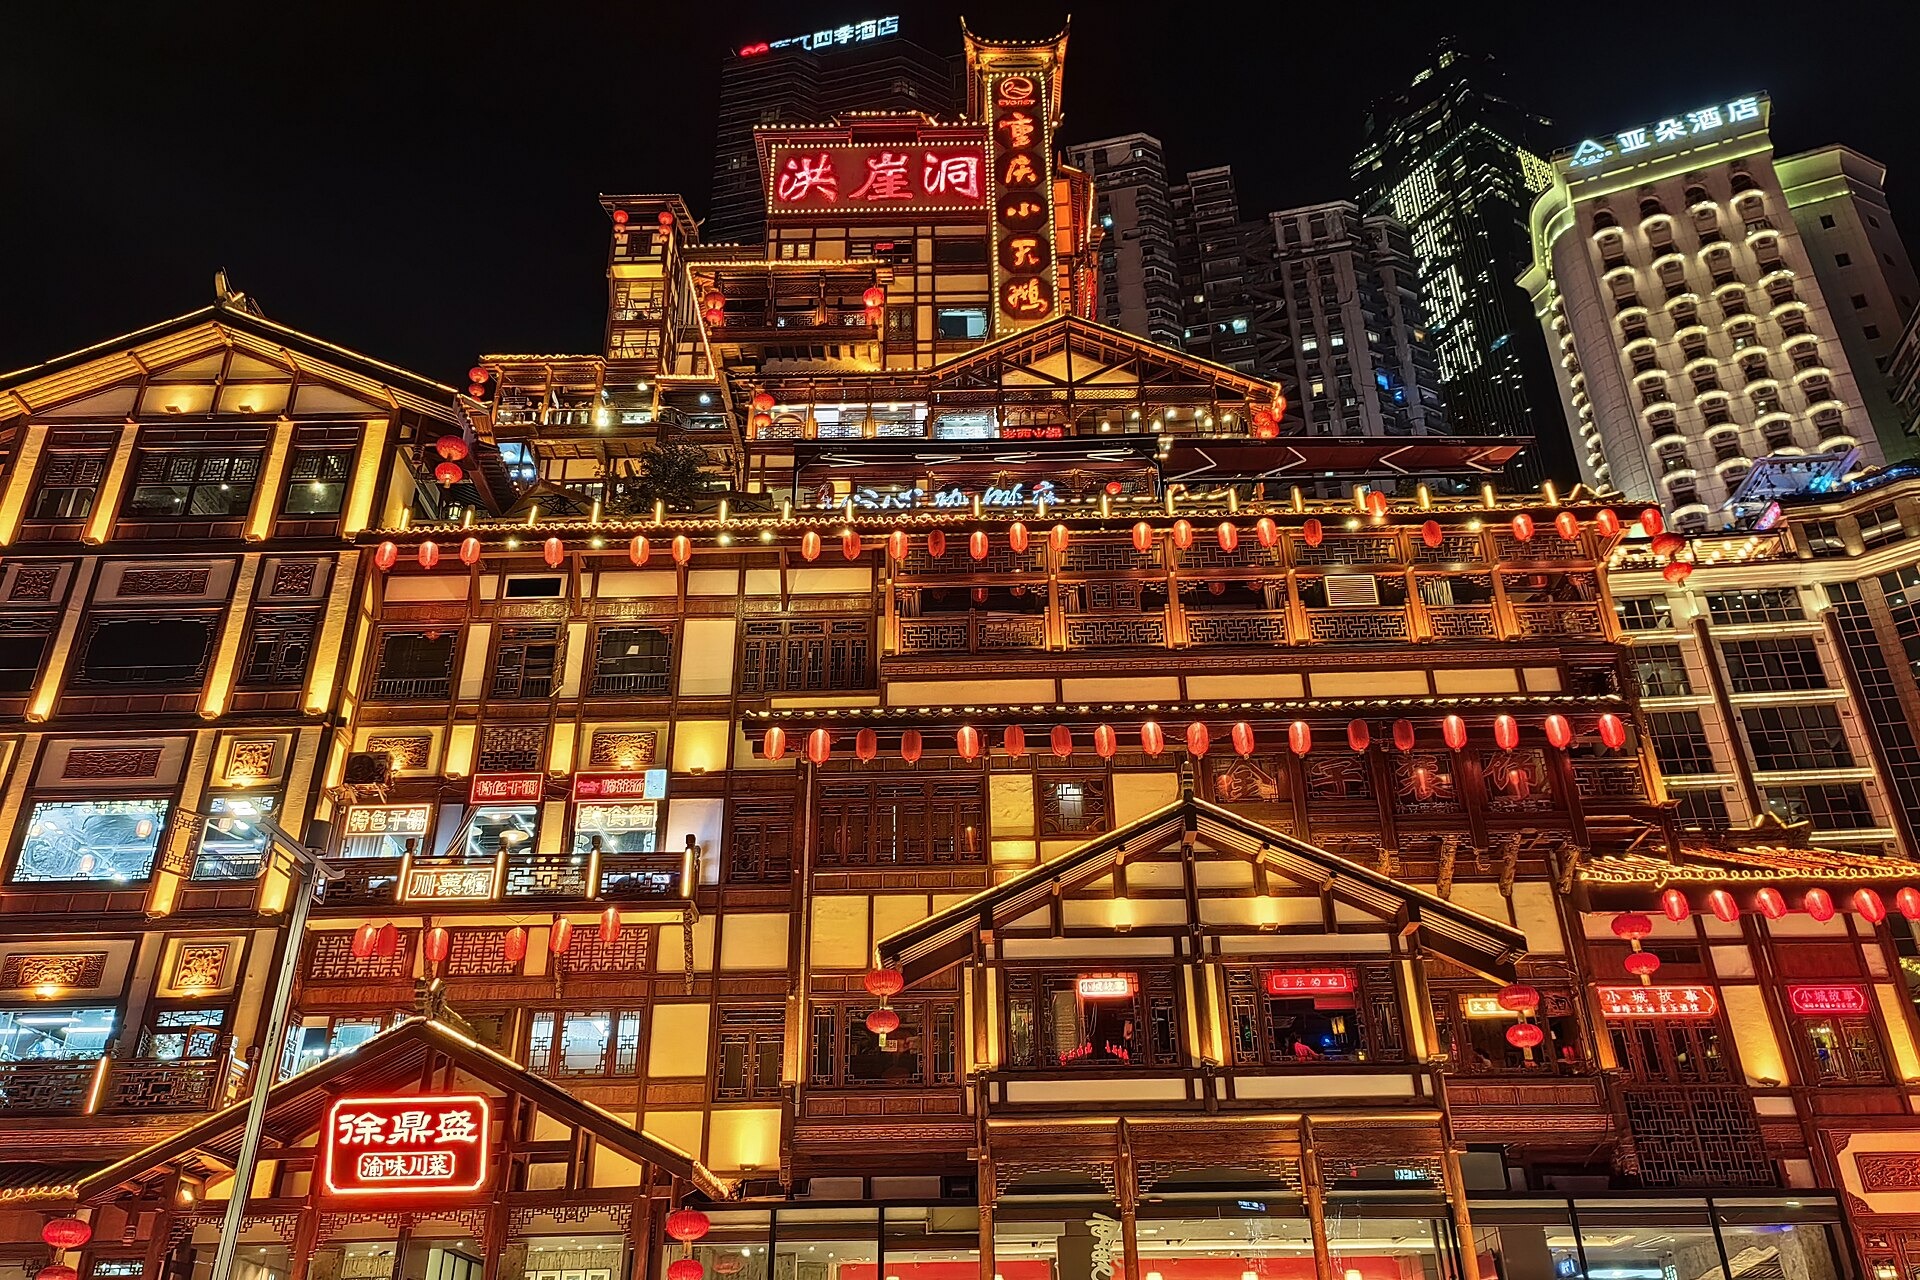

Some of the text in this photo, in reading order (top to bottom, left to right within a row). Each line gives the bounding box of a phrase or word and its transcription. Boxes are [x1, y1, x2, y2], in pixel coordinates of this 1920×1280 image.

[769, 16, 899, 50] 四季酒店
[1617, 97, 1760, 154] 亚朵酒店
[778, 151, 980, 203] 洪崖洞
[999, 111, 1048, 313] 重庆小天鹅
[476, 780, 538, 796] 特色干锅
[350, 809, 426, 831] 特色干锅
[580, 805, 654, 827] 美食街
[410, 873, 490, 896] 川菜馆
[1606, 989, 1700, 1003] 小城故事
[1801, 990, 1855, 1002] 小城故事
[338, 1110, 479, 1145] 徐鼎盛
[362, 1155, 450, 1177] 渝味川菜
